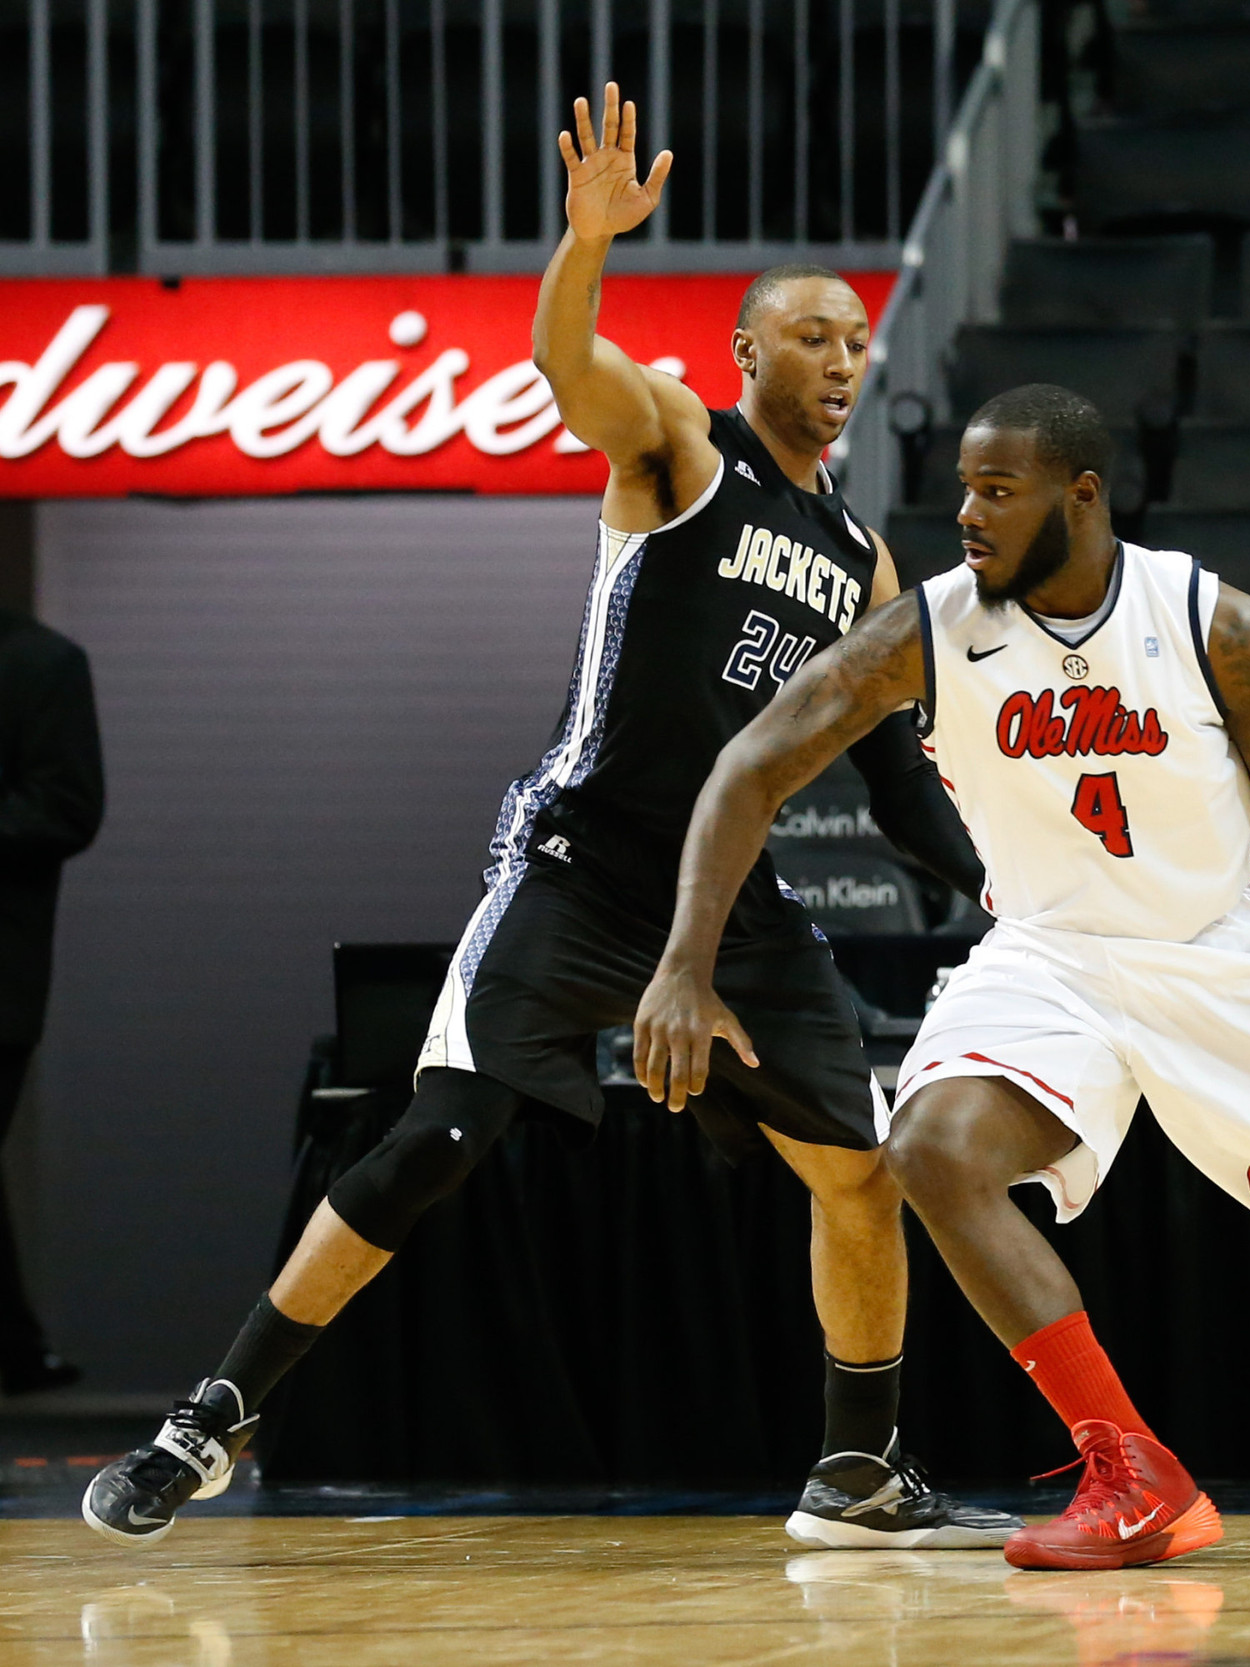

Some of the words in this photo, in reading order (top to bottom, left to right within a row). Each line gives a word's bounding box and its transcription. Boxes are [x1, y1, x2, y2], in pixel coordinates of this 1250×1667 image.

[0, 303, 686, 459] dweise
[718, 524, 862, 636] JACKETS
[722, 609, 817, 697] 24
[1063, 655, 1089, 680] SEC
[996, 688, 1066, 759] Ole
[1060, 685, 1169, 758] Miss
[1071, 771, 1134, 858] 4
[827, 876, 899, 907] Klein
